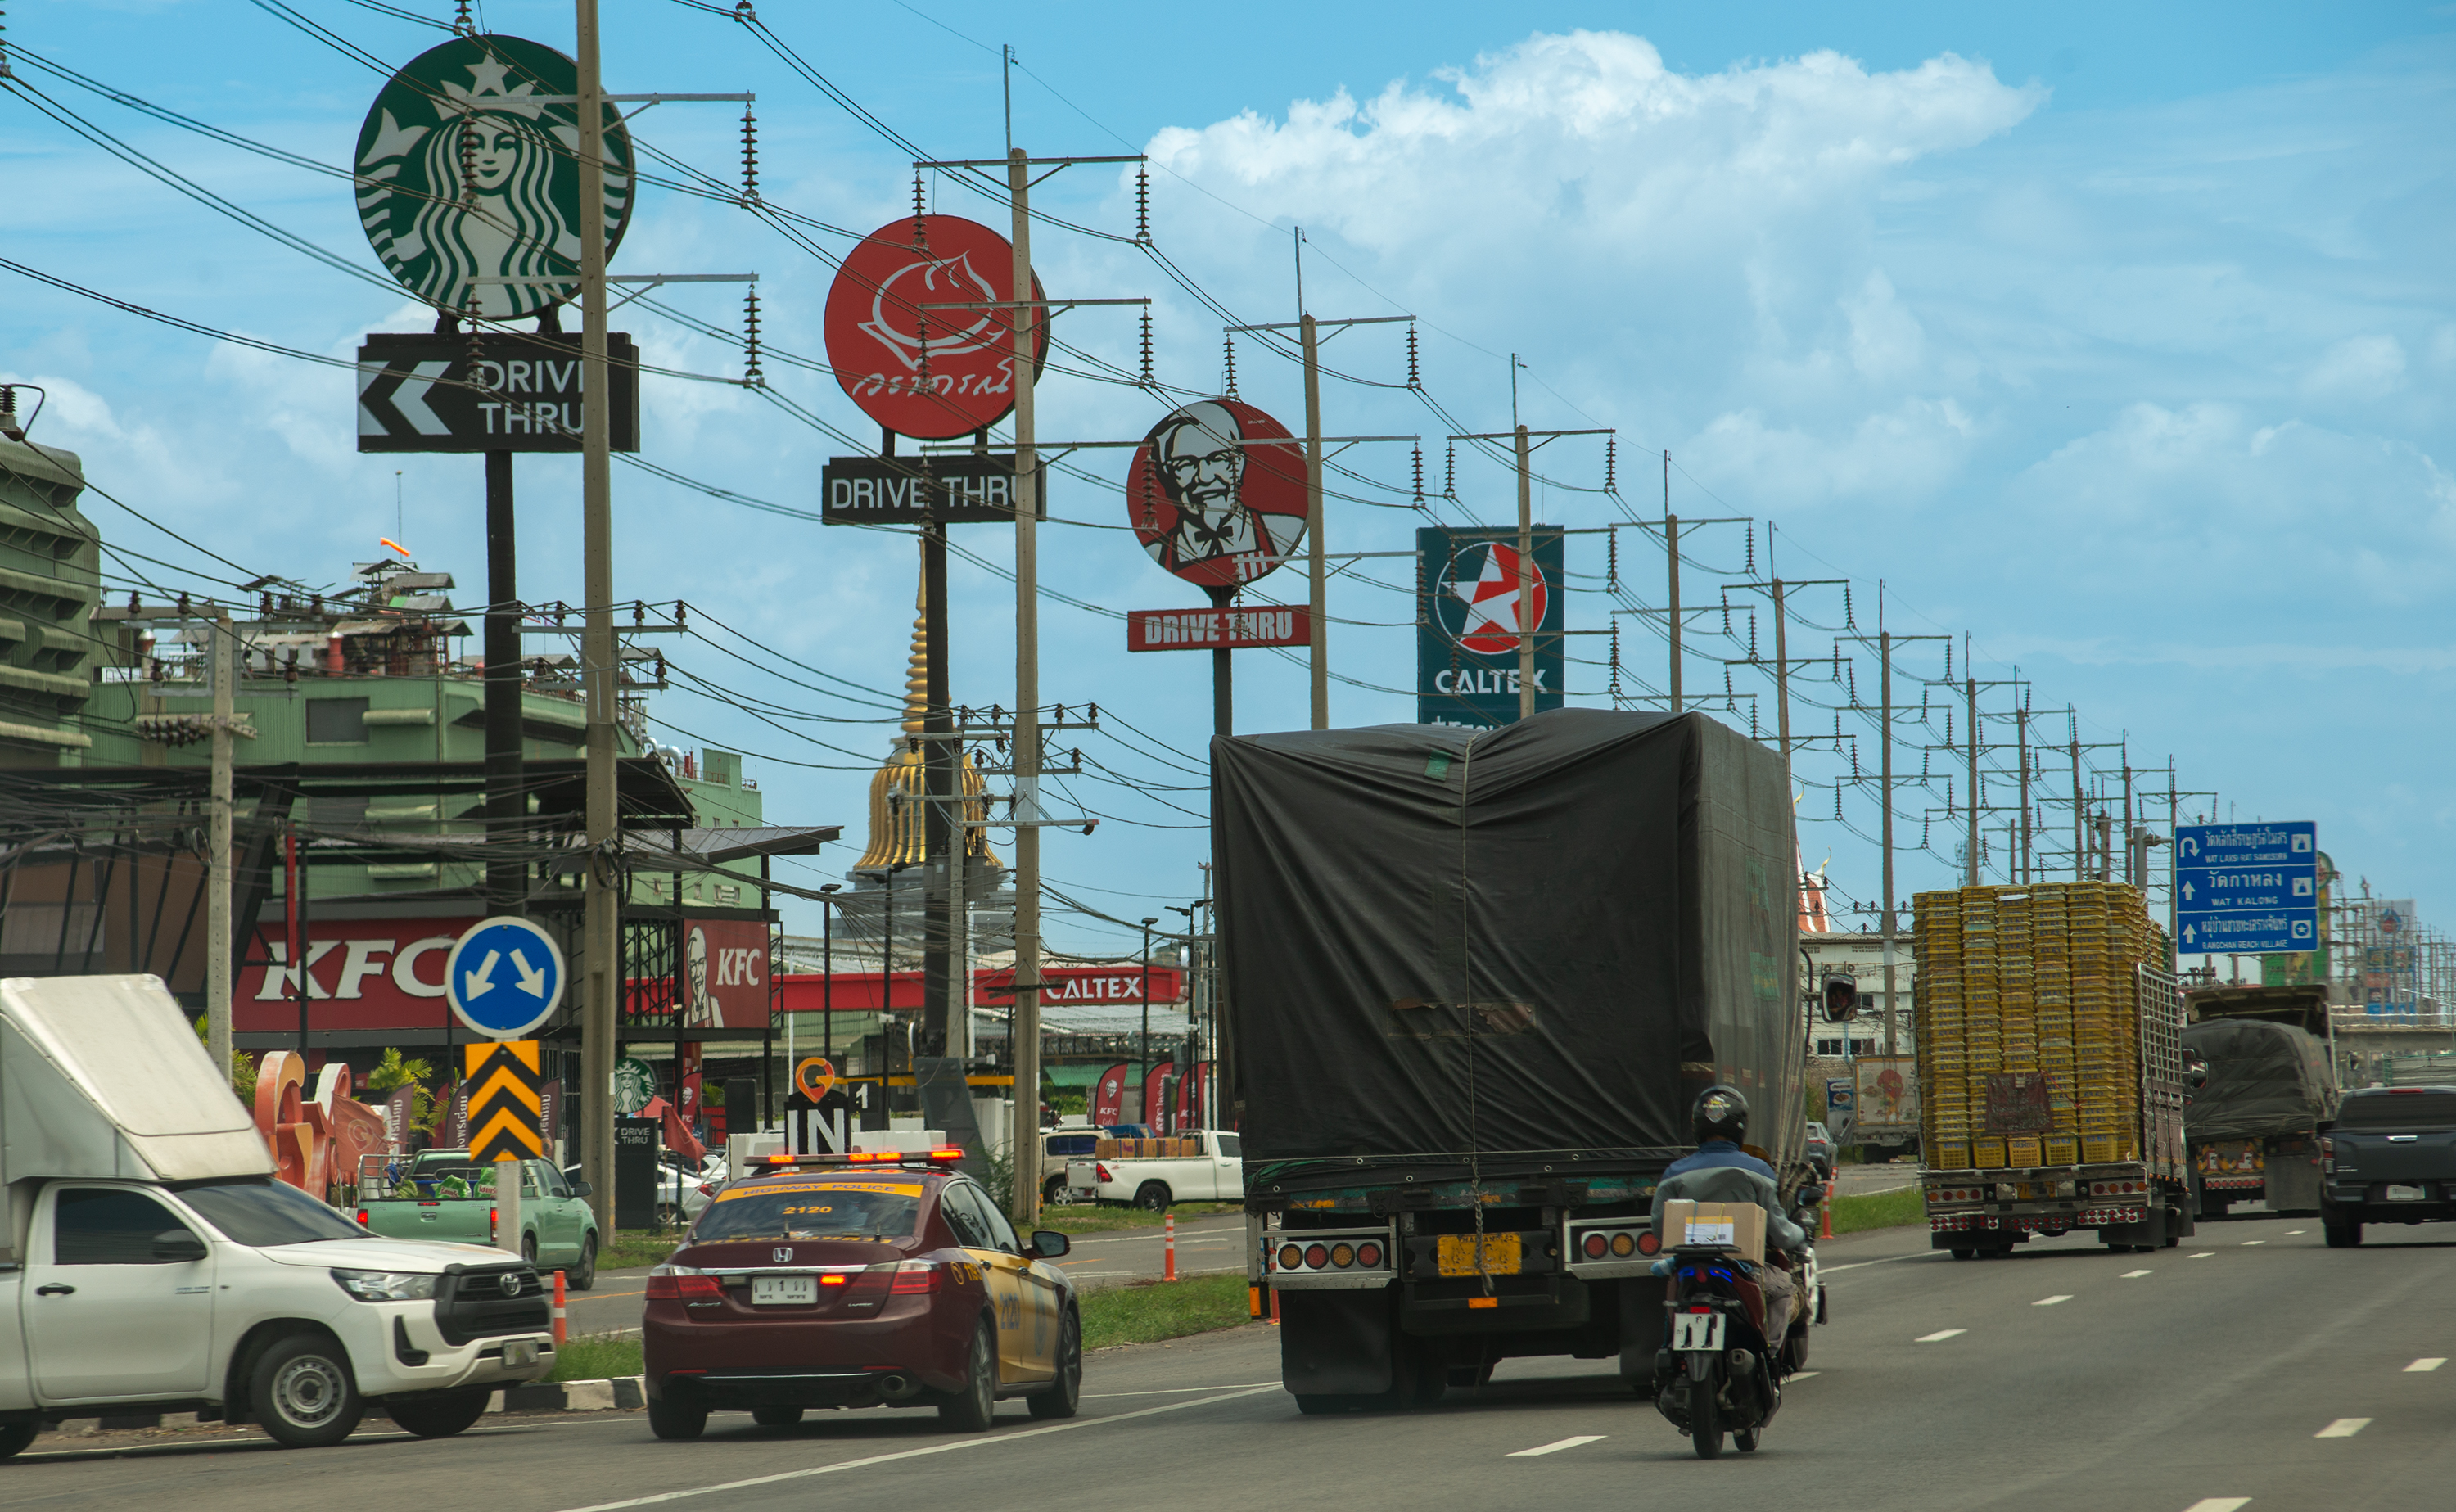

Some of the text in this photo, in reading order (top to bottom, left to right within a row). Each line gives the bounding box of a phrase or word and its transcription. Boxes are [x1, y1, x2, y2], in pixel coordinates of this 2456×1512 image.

[479, 359, 584, 393] DRIV
[831, 476, 924, 510] DRIVE
[1144, 611, 1293, 644] DRIVE THRU
[1434, 669, 1549, 695] CALTEX
[2205, 855, 2218, 863] WAT
[2207, 870, 2282, 888] วัดกาหลง
[2211, 896, 2278, 906] WAT KALONG
[2238, 941, 2260, 949] BEACH
[2261, 939, 2288, 948] VILLAGE
[255, 938, 457, 1000] KFC
[715, 948, 761, 986] KFC
[1046, 977, 1142, 1000] CALTEX
[681, 1114, 693, 1123] FC
[1099, 1107, 1118, 1116] KFC
[621, 1127, 651, 1136] DRIVE
[621, 1136, 648, 1144] THRU
[788, 1108, 845, 1154] IN
[743, 1183, 896, 1196] HIGHWAY POLICE
[782, 1206, 833, 1215] 2120
[1000, 1293, 1021, 1330] 2120
